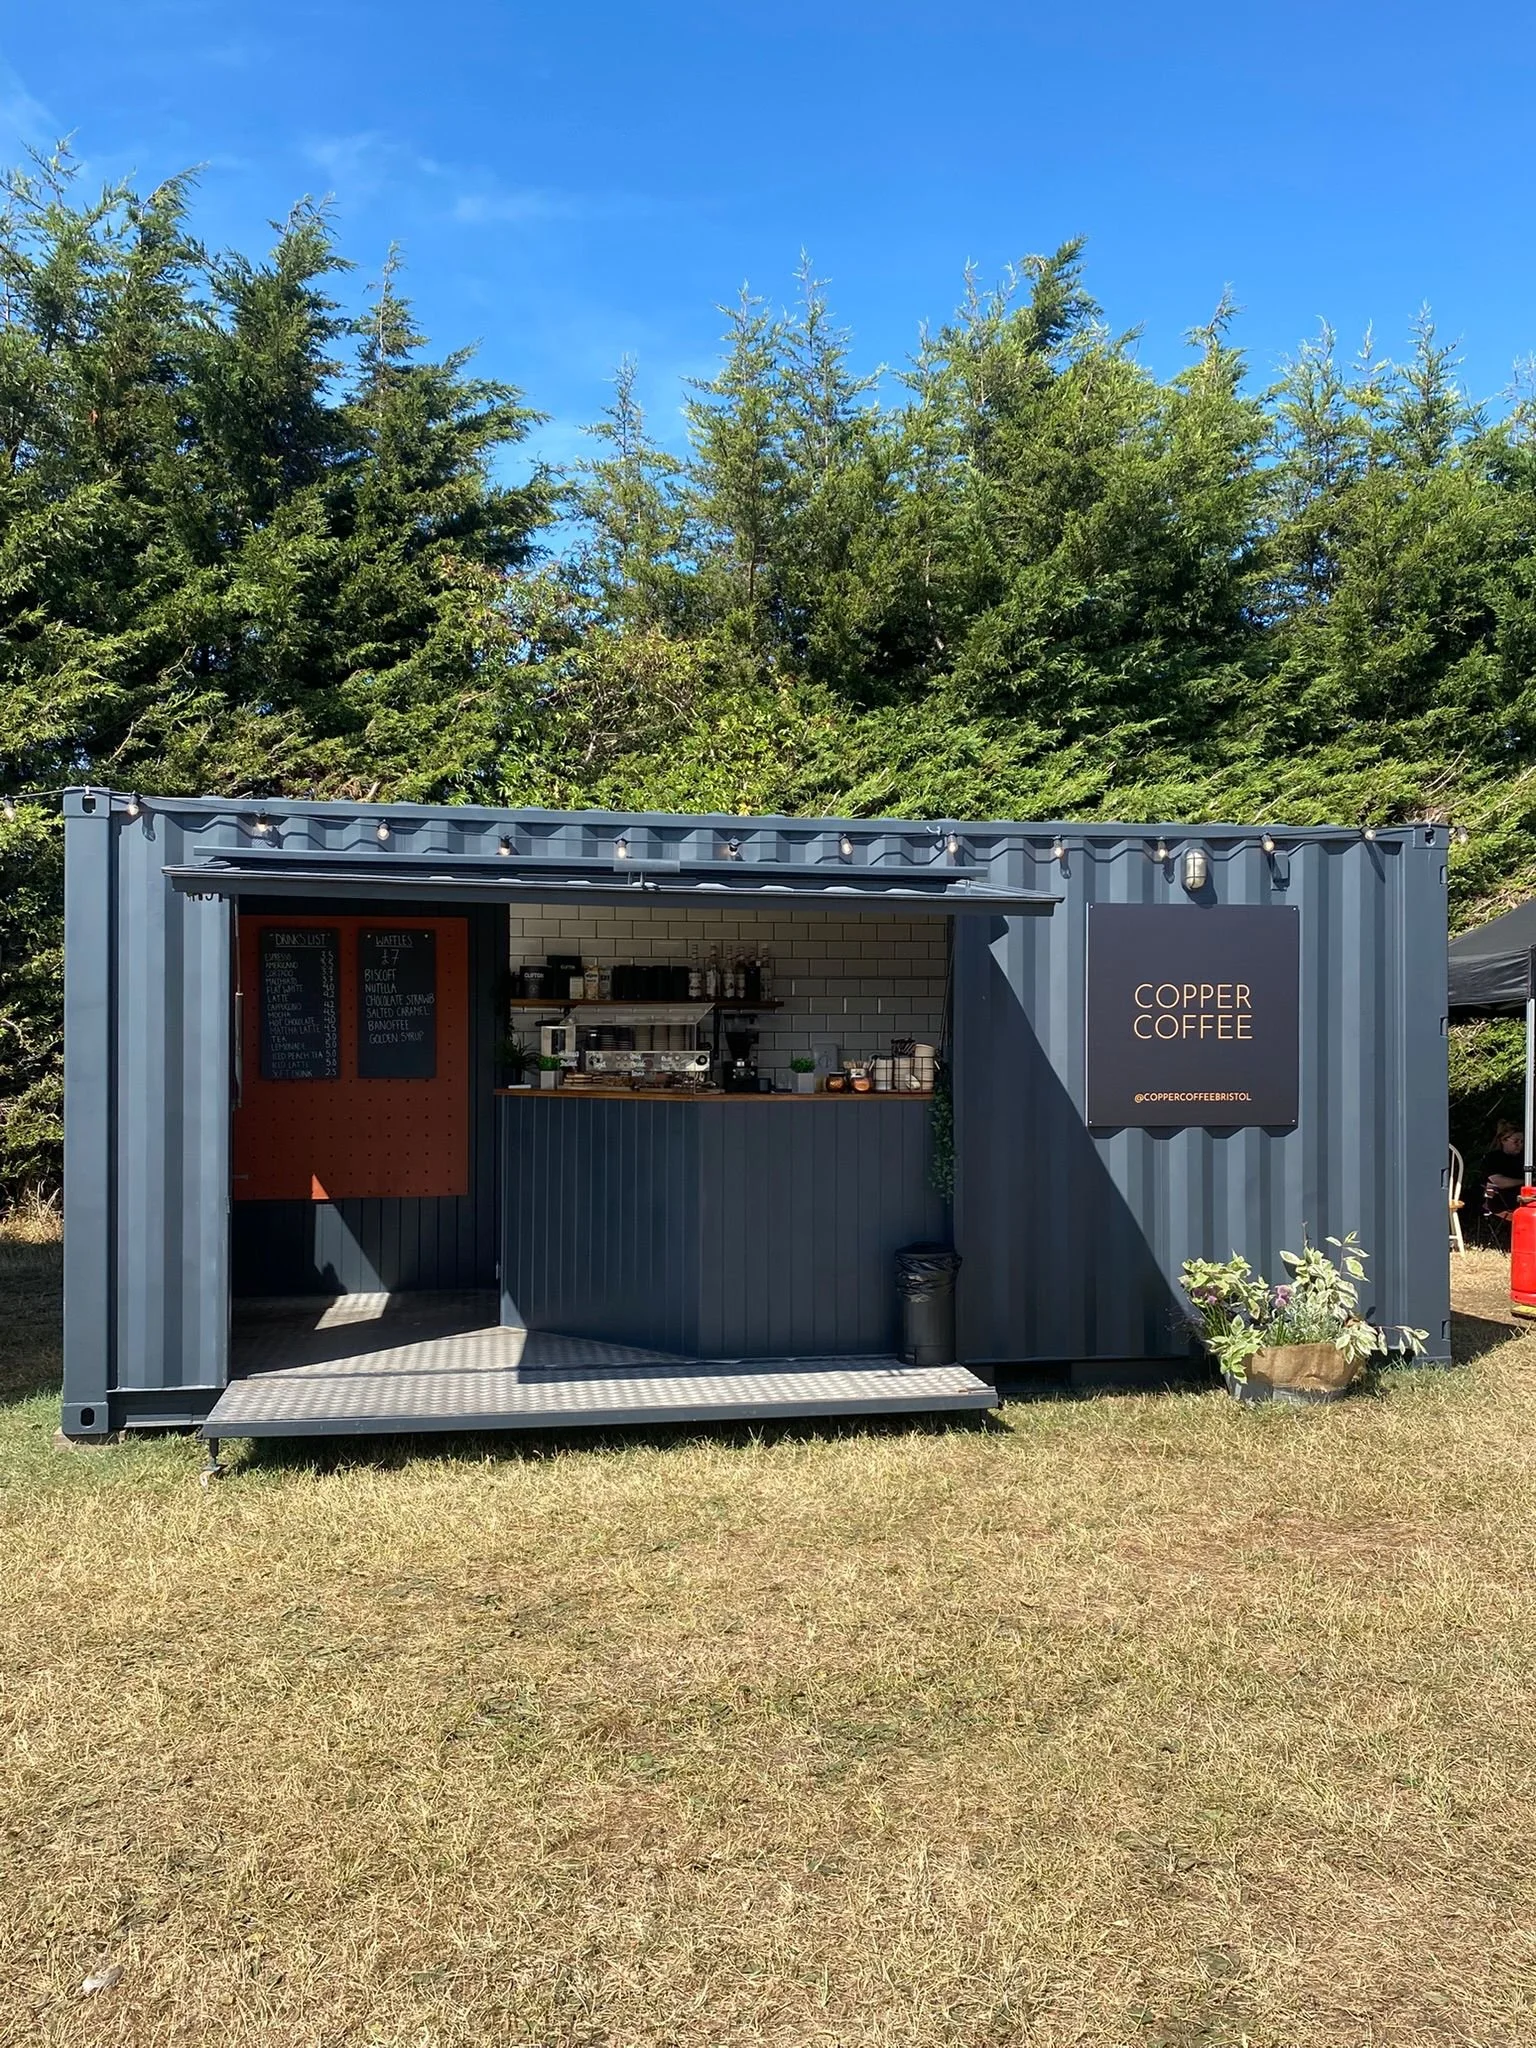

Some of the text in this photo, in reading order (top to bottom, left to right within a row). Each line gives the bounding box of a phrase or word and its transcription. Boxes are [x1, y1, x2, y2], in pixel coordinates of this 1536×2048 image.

[307, 933, 326, 945] LIST
[375, 934, 413, 946] WAFFLES
[382, 948, 400, 966] £7
[364, 969, 396, 982] BISCOFF
[266, 985, 281, 994] FLAT
[282, 984, 304, 993] WHITE
[365, 983, 397, 994] NUTELLA
[267, 994, 289, 1003] LATTE
[366, 993, 436, 1007] CHOCOLATE STRAWB
[1134, 983, 1252, 1009] COPPER
[366, 1006, 429, 1019] SALTED CARAMEL
[284, 1017, 315, 1025] CHOCOLATE
[368, 1020, 409, 1032] BANOFFEE
[1133, 1014, 1253, 1039] COFFEE
[300, 1024, 320, 1034] LATTE
[272, 1035, 287, 1043] TEA
[369, 1032, 425, 1044] GOLDEN SYRUP
[288, 1052, 310, 1060] PEACH
[312, 1051, 324, 1059] TEA
[288, 1061, 310, 1069] LATTE
[1134, 1092, 1252, 1104] @COPPERCOFFEEBRISTOL
